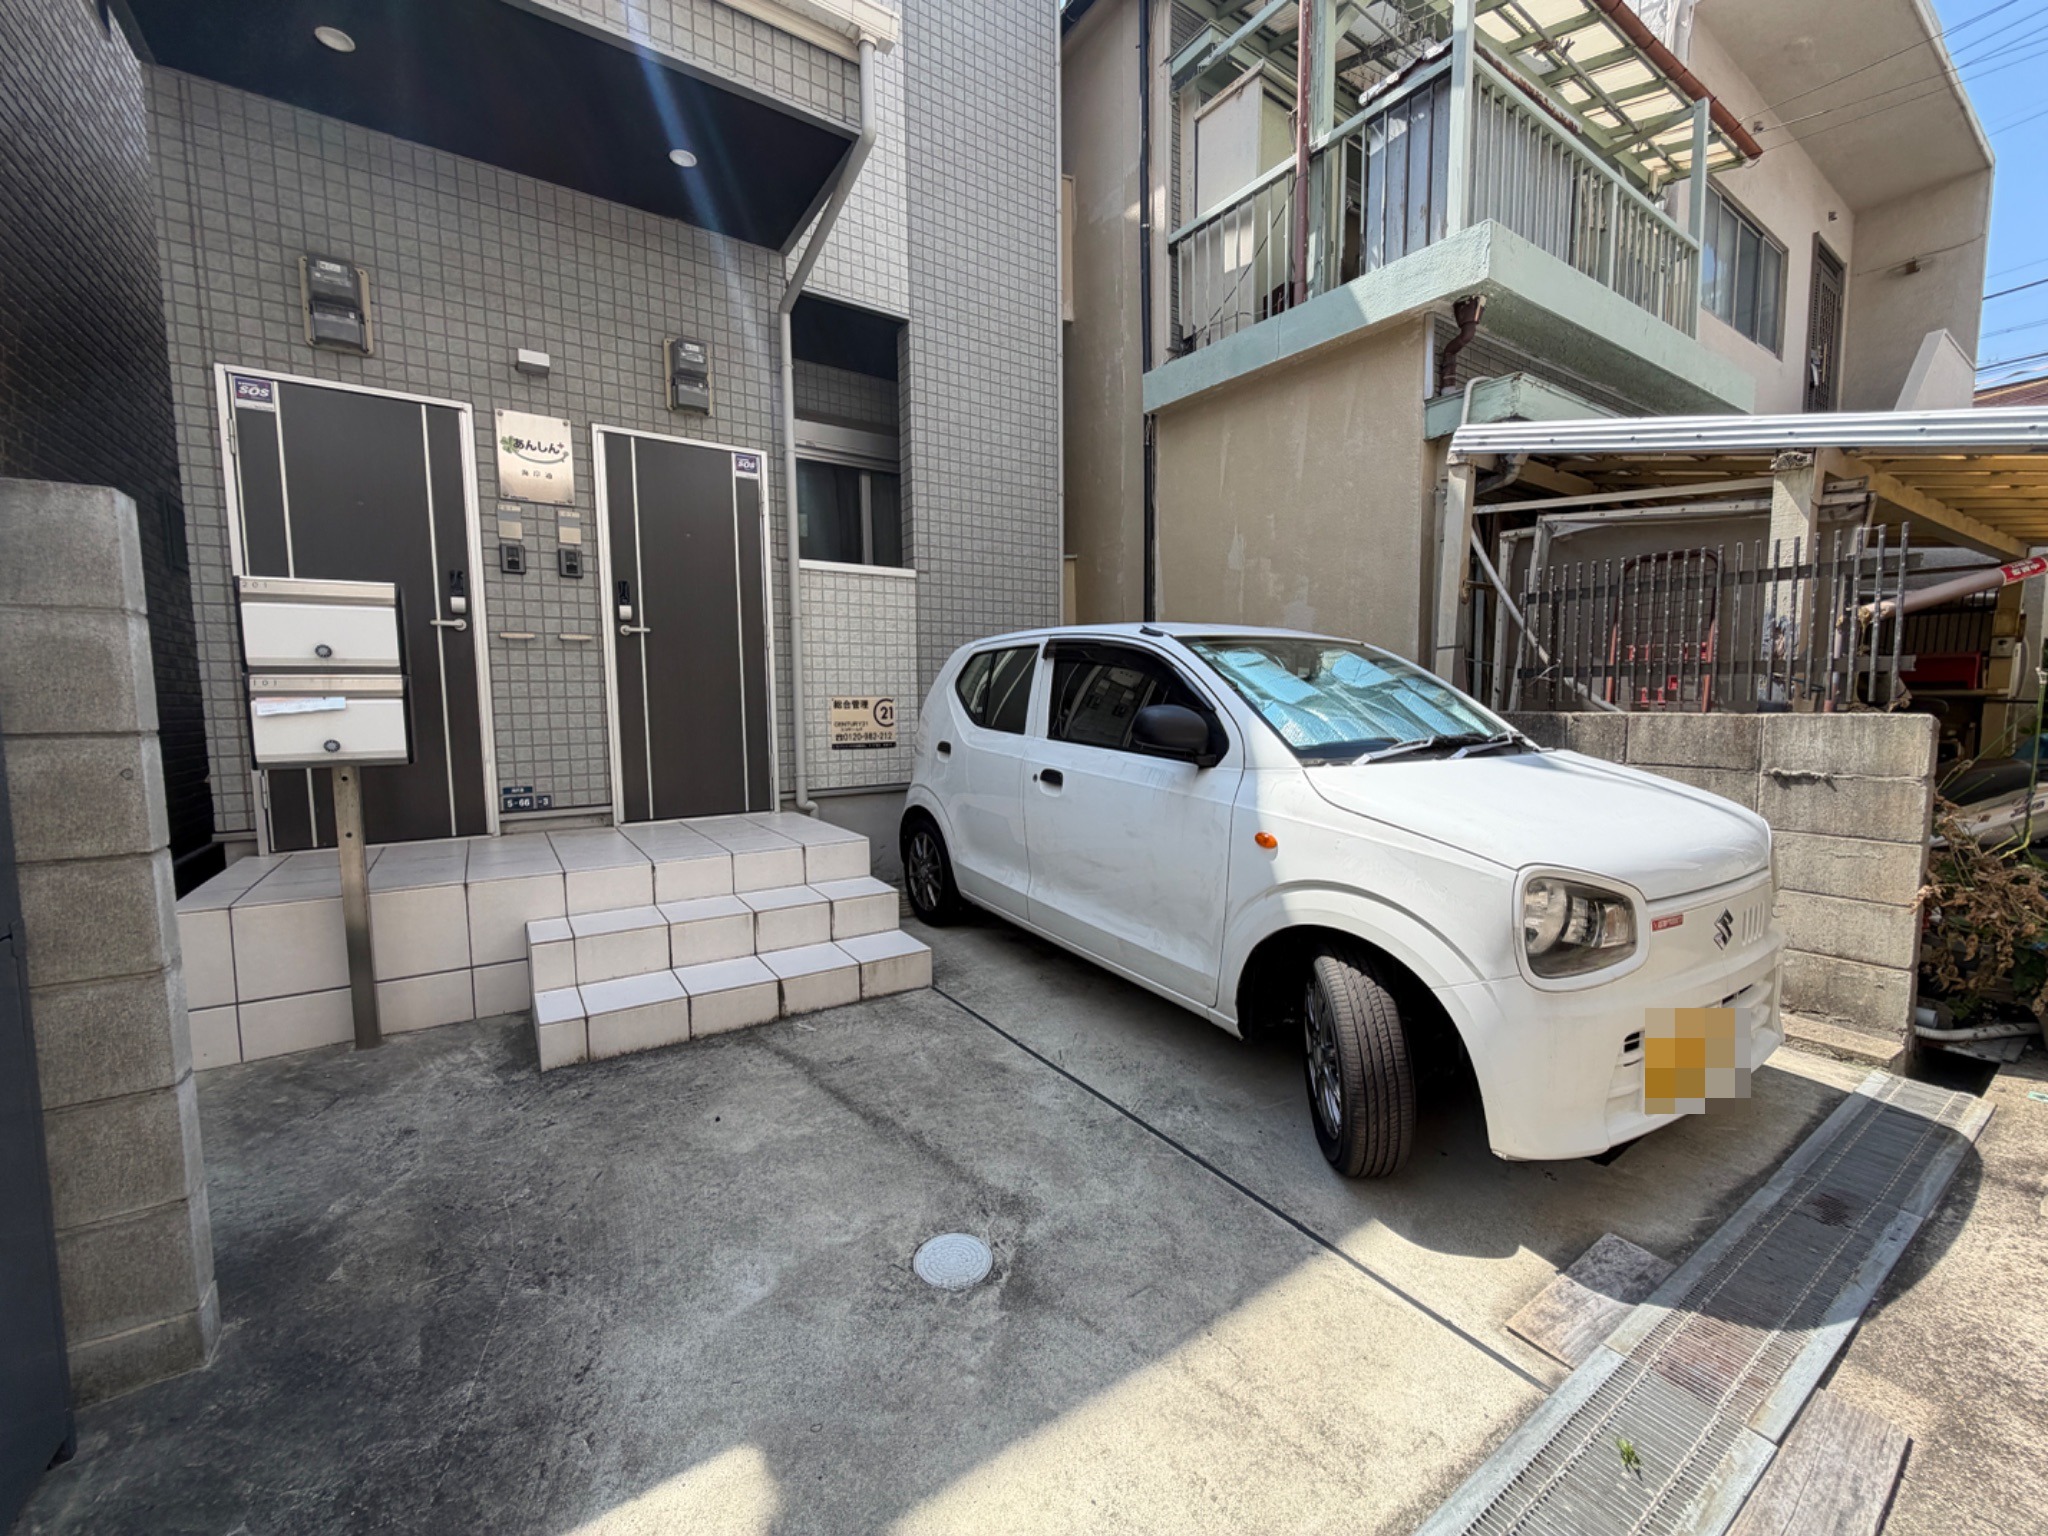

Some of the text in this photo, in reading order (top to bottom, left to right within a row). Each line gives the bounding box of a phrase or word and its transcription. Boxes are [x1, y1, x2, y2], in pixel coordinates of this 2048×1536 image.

[238, 385, 270, 397] SOS
[833, 699, 869, 709] 総合管理
